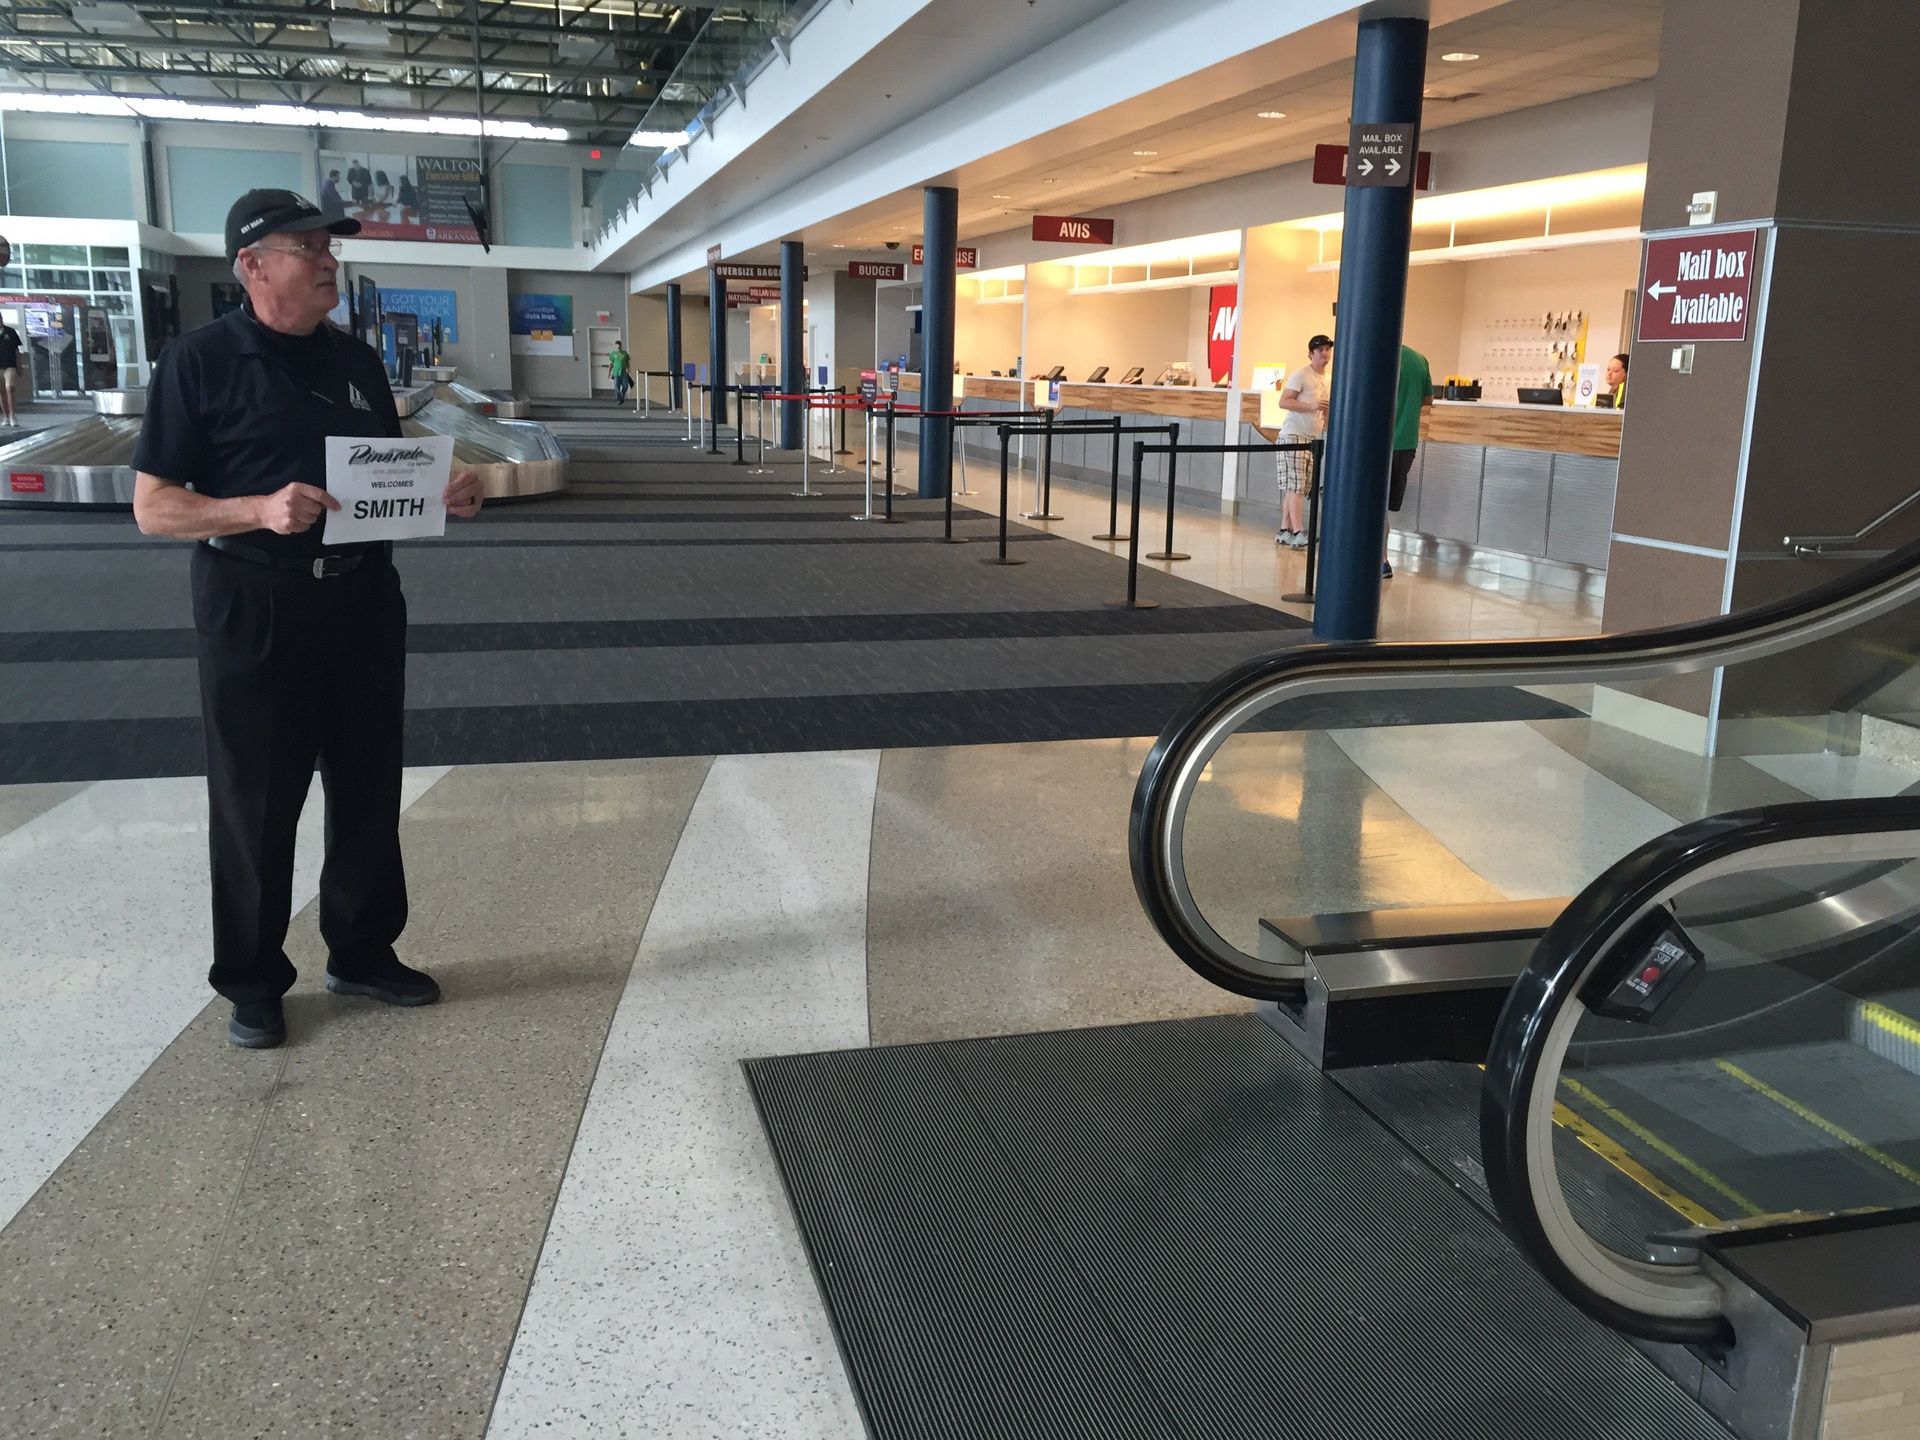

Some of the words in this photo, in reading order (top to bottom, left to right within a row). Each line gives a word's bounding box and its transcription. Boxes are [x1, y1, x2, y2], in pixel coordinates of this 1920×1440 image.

[1362, 134, 1382, 143] MAIL
[1384, 133, 1403, 142] BOX
[1359, 145, 1404, 155] AVAILABLE
[417, 157, 482, 172] WALTON
[1059, 222, 1091, 239] AVIS
[716, 266, 754, 277] OVERSIZE
[756, 268, 782, 278] BAGG
[858, 265, 897, 277] BUDGET
[1677, 249, 1712, 282] Mail
[1714, 248, 1747, 279] box
[390, 294, 415, 305] GOT
[418, 295, 449, 305] YOUR
[1671, 292, 1744, 325] Available
[1211, 306, 1238, 341] AV
[348, 444, 425, 466] Pinnacle
[371, 480, 414, 489] WELCOMES
[353, 498, 425, 519] SMITH
